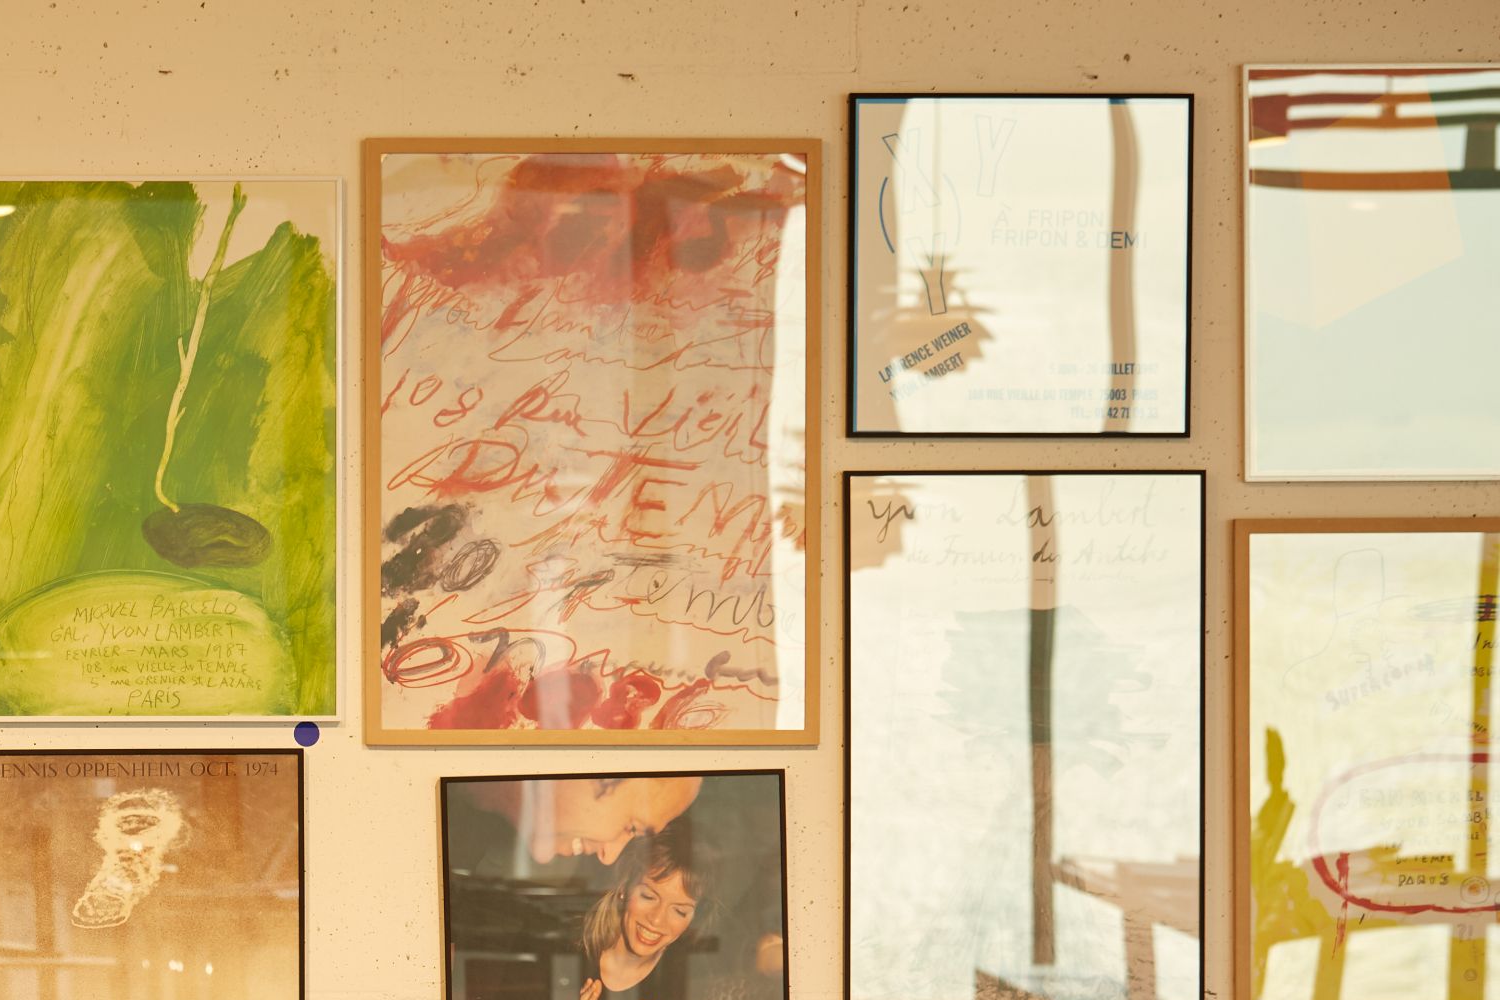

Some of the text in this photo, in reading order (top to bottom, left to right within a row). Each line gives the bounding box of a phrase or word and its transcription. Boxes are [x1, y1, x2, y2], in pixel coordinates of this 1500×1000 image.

[930, 322, 972, 352] WEINER
[65, 762, 181, 778] OPPENHEIM
[190, 762, 237, 777] OCT.
[245, 762, 279, 776] 1974
